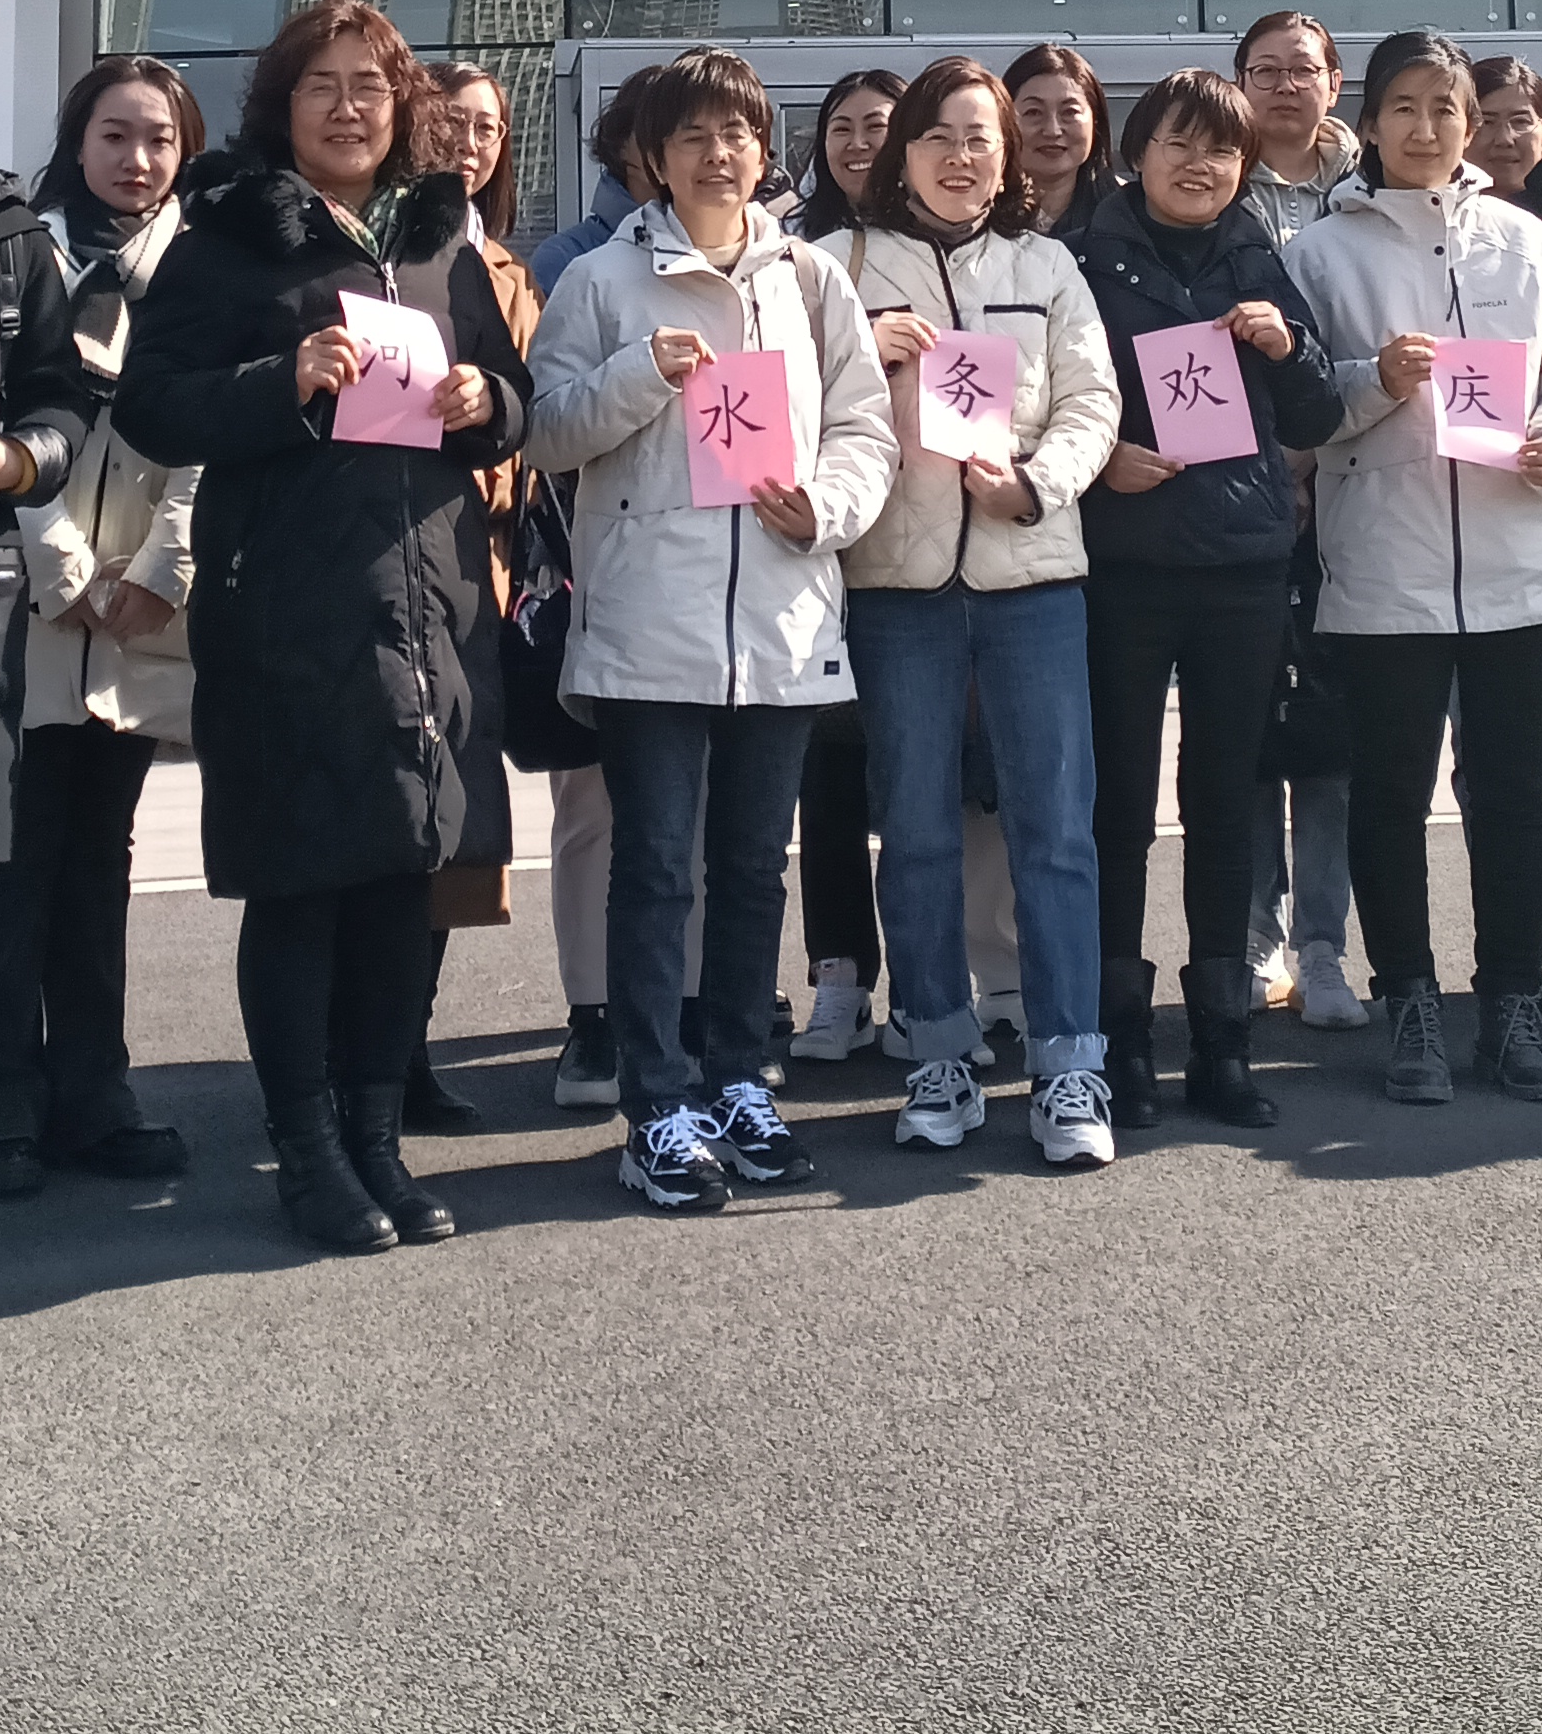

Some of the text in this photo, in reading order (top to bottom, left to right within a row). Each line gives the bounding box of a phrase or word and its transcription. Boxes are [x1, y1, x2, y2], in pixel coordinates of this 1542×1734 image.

[359, 336, 411, 391] 河
[935, 352, 996, 419] 务
[1159, 351, 1229, 413] 欢
[1444, 364, 1502, 421] 庆
[699, 383, 767, 450] 水
